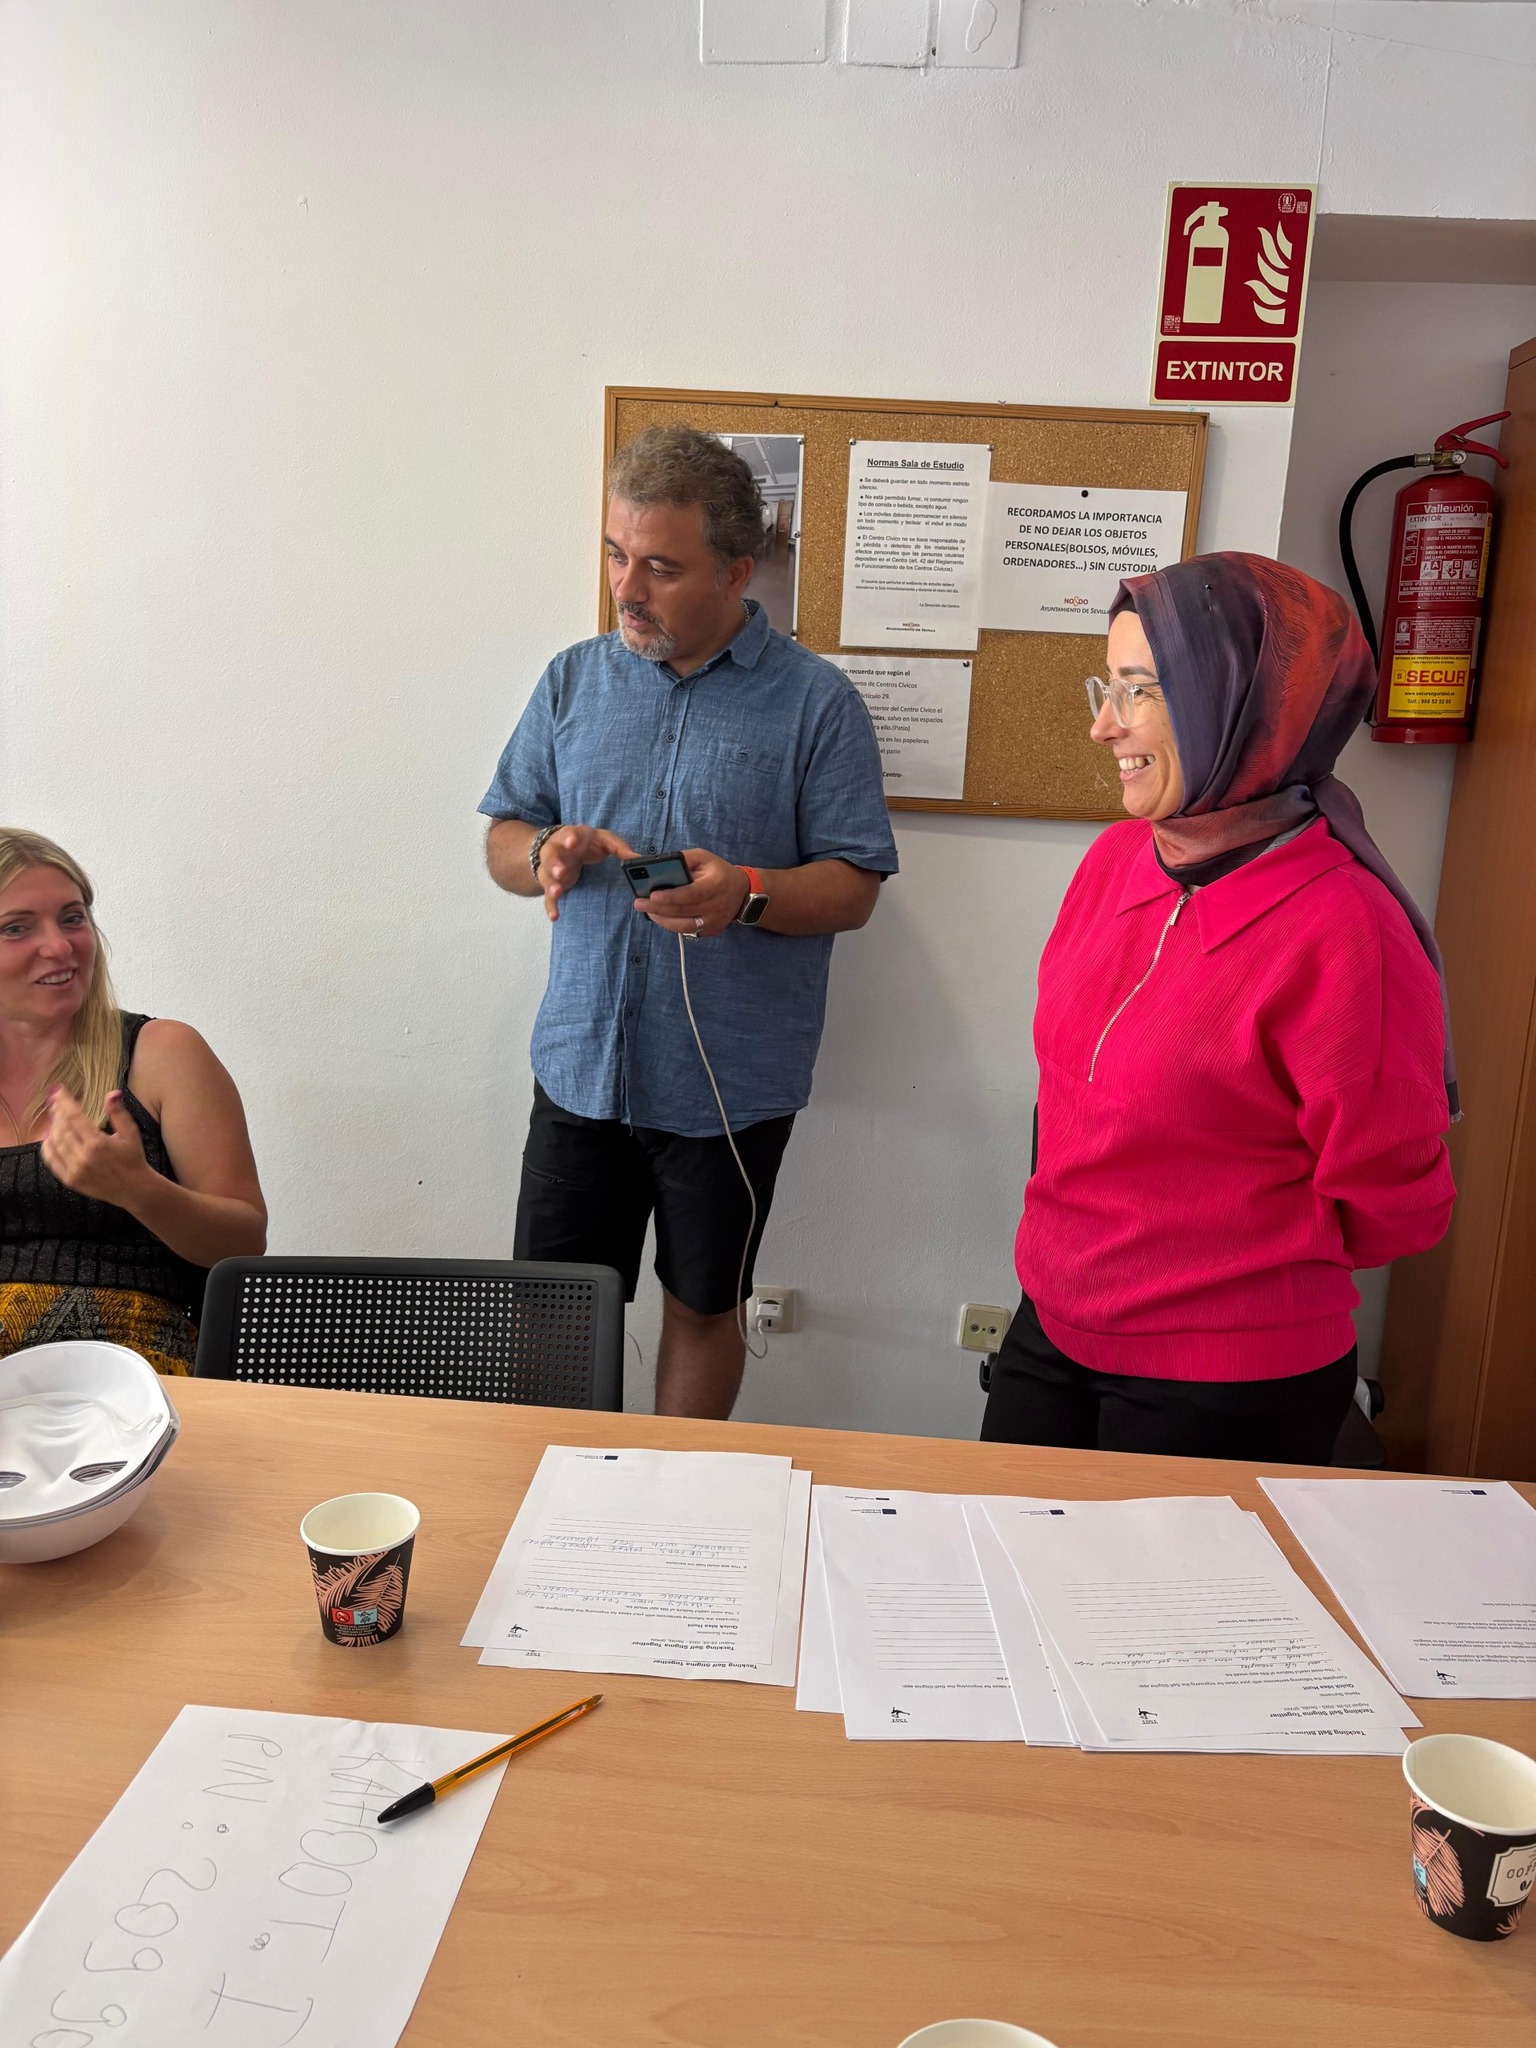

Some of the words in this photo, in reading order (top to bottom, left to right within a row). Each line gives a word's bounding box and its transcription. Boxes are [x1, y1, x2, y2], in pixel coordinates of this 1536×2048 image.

[1166, 361, 1283, 381] EXTINTOR
[868, 459, 899, 468] Normas
[900, 460, 919, 469] Sala
[920, 461, 931, 469] de
[933, 461, 964, 470] Estudio
[1008, 508, 1076, 519] RECORDAMOS
[1079, 512, 1090, 520] LA
[1093, 513, 1162, 523] IMPORTANCIA
[1424, 504, 1473, 513] Valleunión
[1020, 525, 1032, 533] DE
[1034, 526, 1050, 534] NO
[1052, 527, 1082, 536] DEJAR
[1084, 528, 1102, 537] LOS
[1104, 530, 1147, 539] OBJETOS
[1006, 541, 1109, 554] PERSONALES(BOLSOS,
[1112, 545, 1158, 558] MÓVILES,
[1003, 557, 1087, 570] ORDENADORES...)
[1089, 562, 1106, 570] SIN
[1108, 563, 1157, 575] CUSTODIA
[1407, 670, 1466, 682] SECUR
